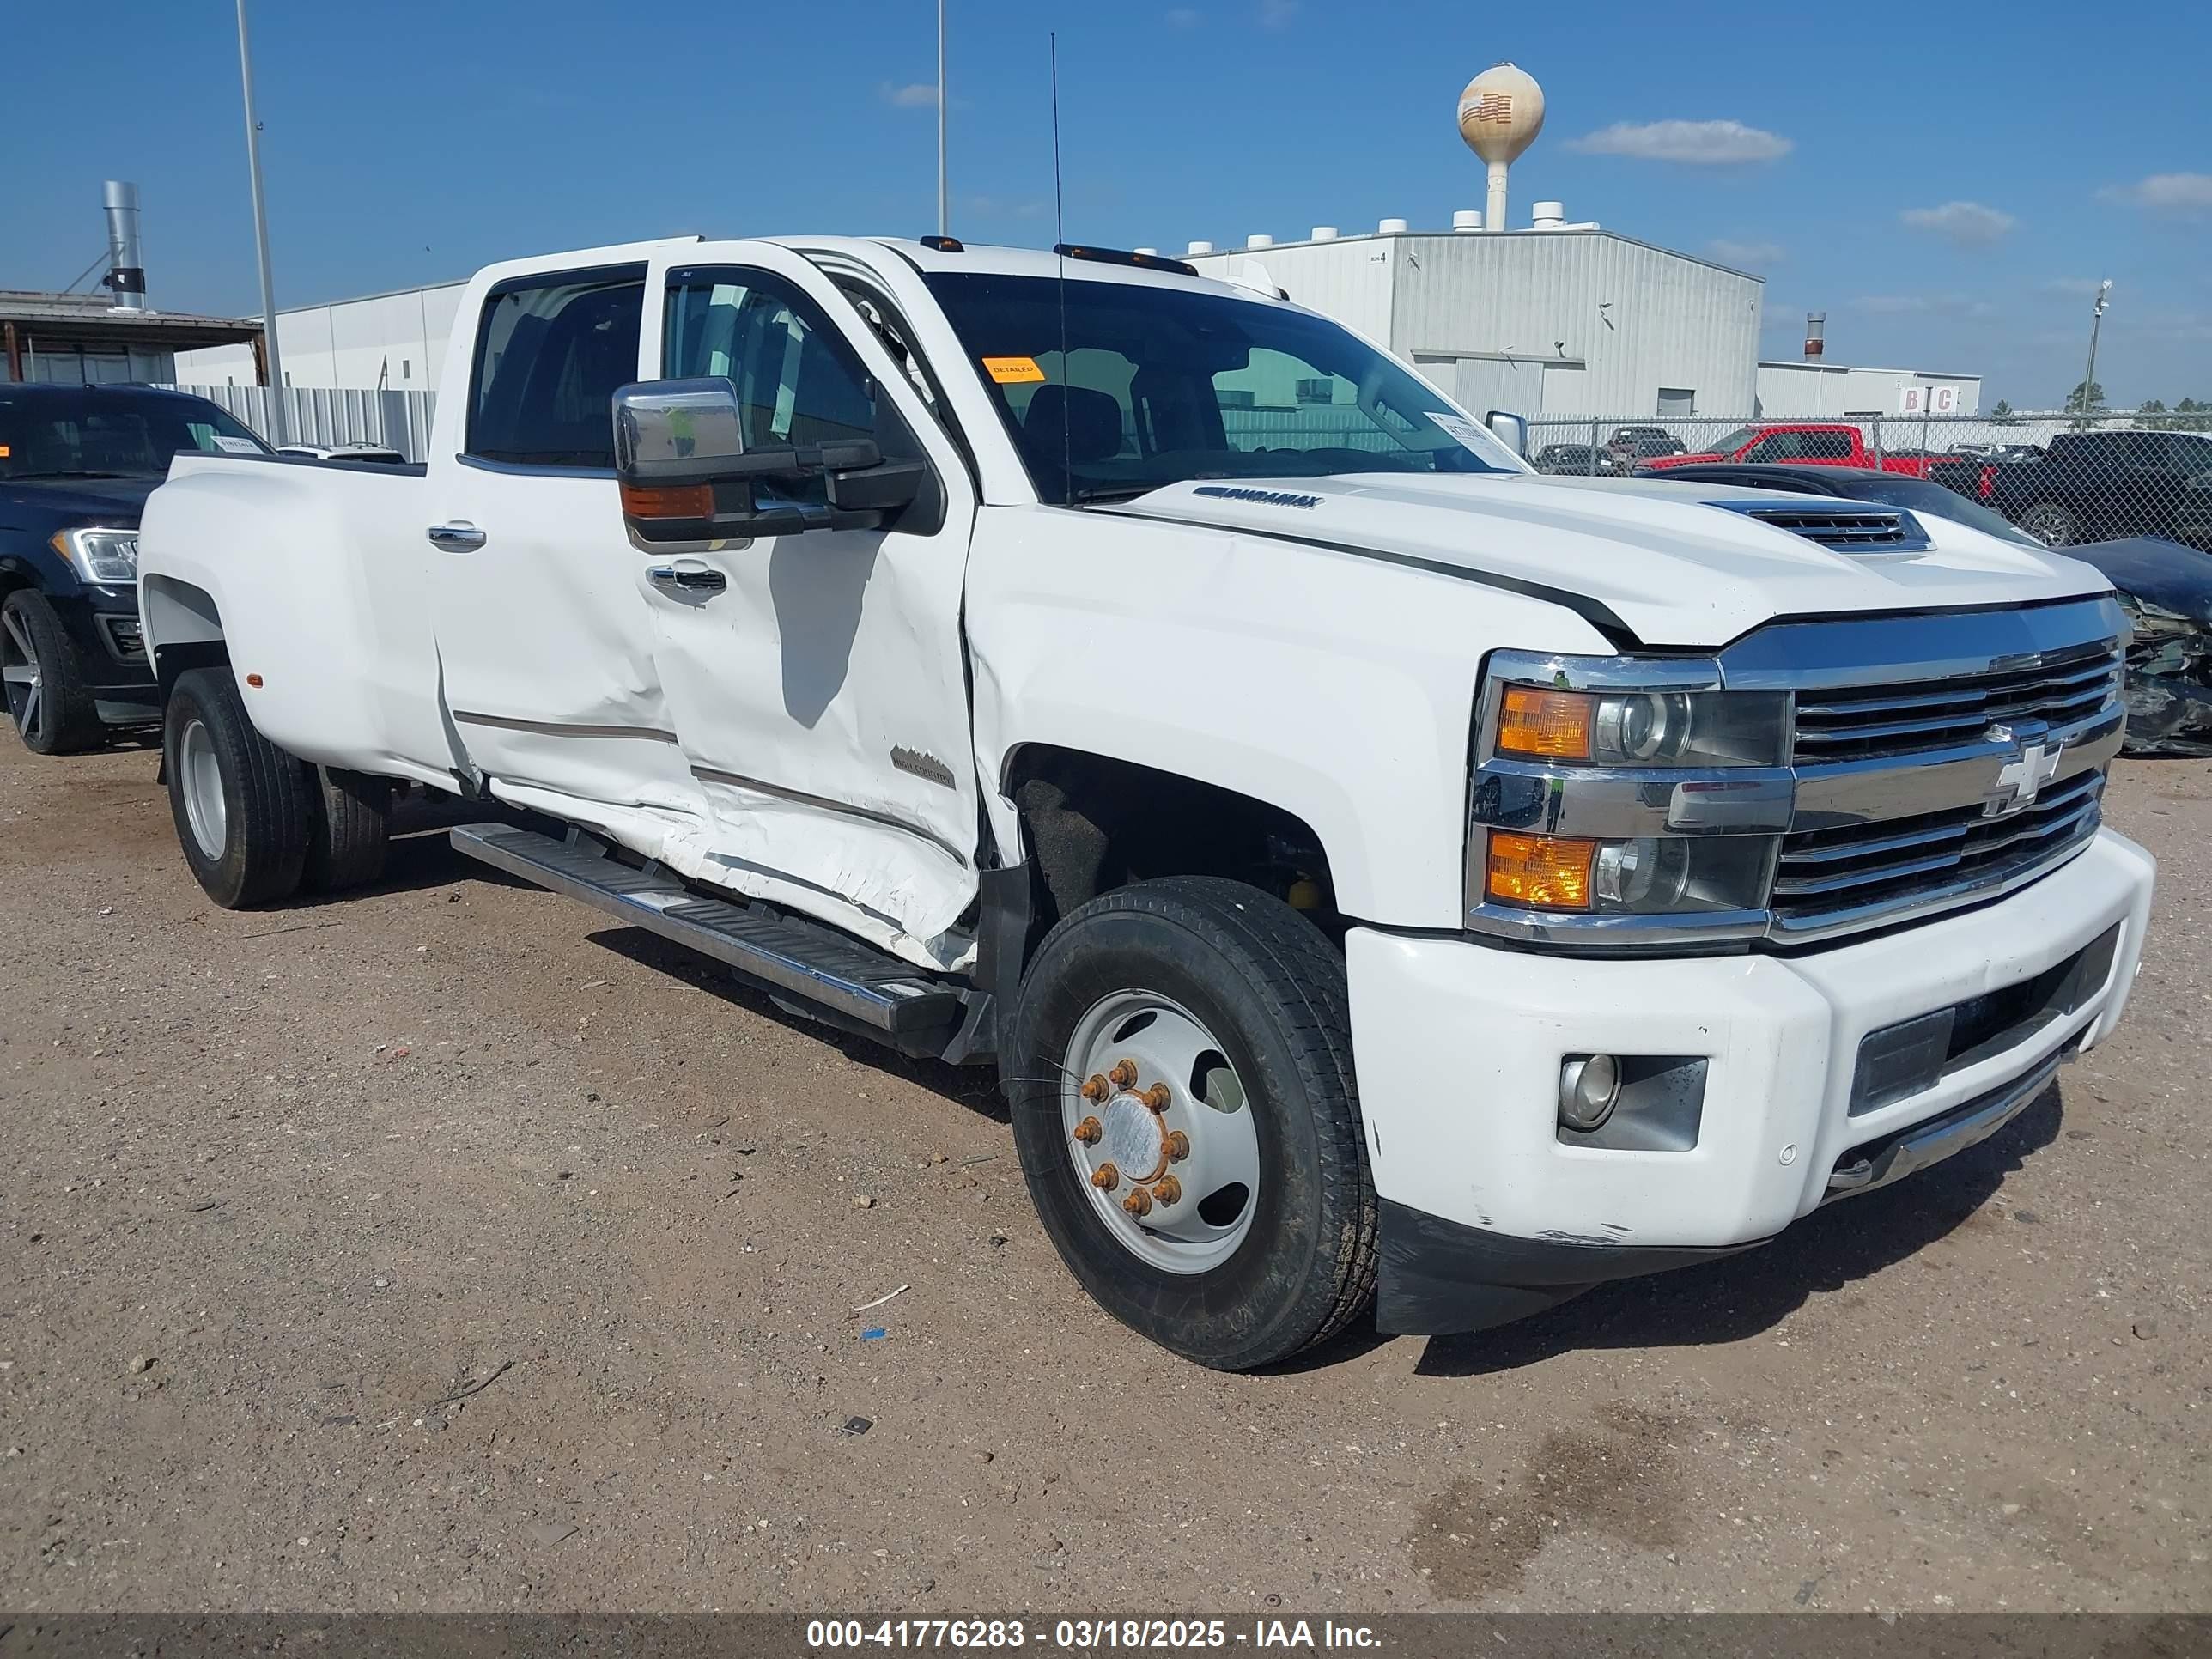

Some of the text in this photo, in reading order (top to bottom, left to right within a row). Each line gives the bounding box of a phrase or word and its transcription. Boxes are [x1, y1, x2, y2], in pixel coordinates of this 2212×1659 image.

[1905, 390, 1918, 410] B
[1938, 389, 1952, 410] C
[1224, 488, 1322, 509] DURAMAX
[914, 764, 951, 784] COUNTRY
